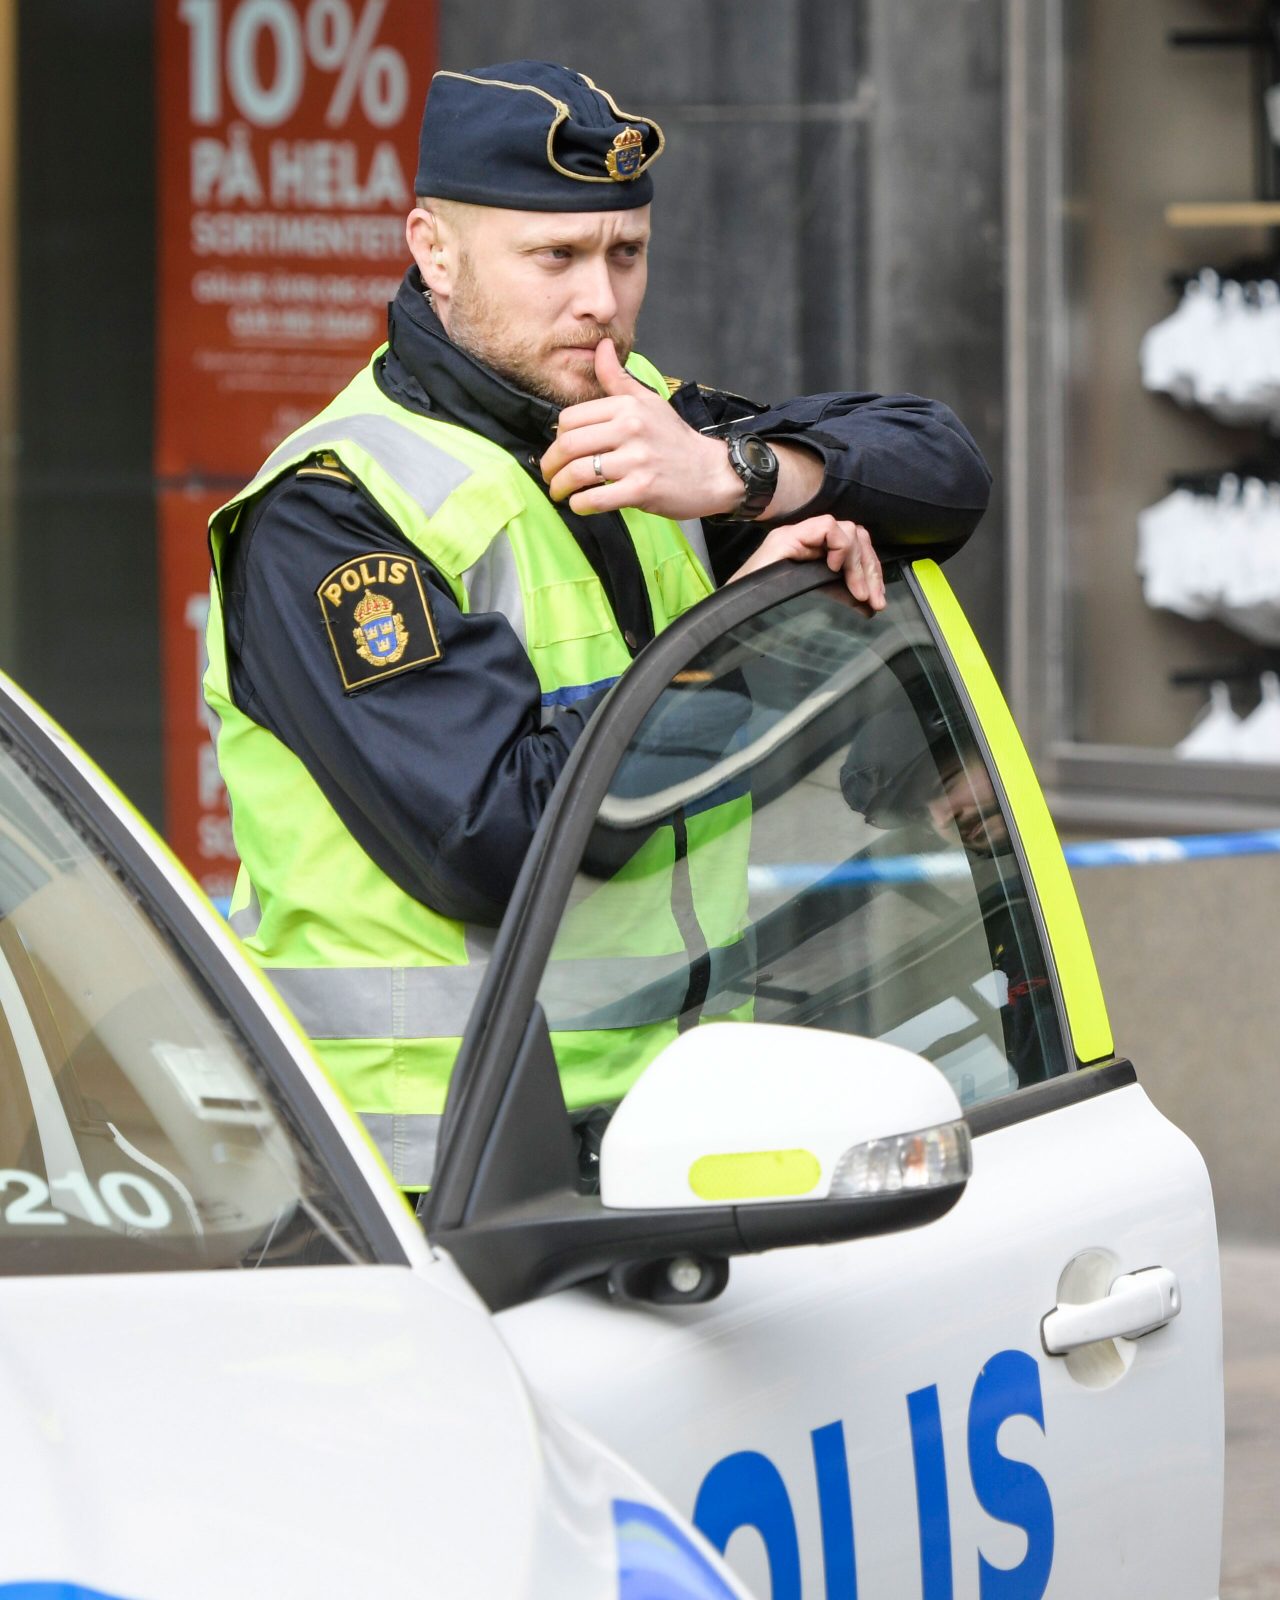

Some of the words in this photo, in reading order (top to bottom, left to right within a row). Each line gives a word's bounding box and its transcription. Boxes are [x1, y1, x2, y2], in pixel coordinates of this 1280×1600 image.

[178, 0, 409, 129] 10%
[190, 120, 263, 207] PÅ
[269, 137, 409, 210] HELA
[323, 560, 408, 608] POLIS
